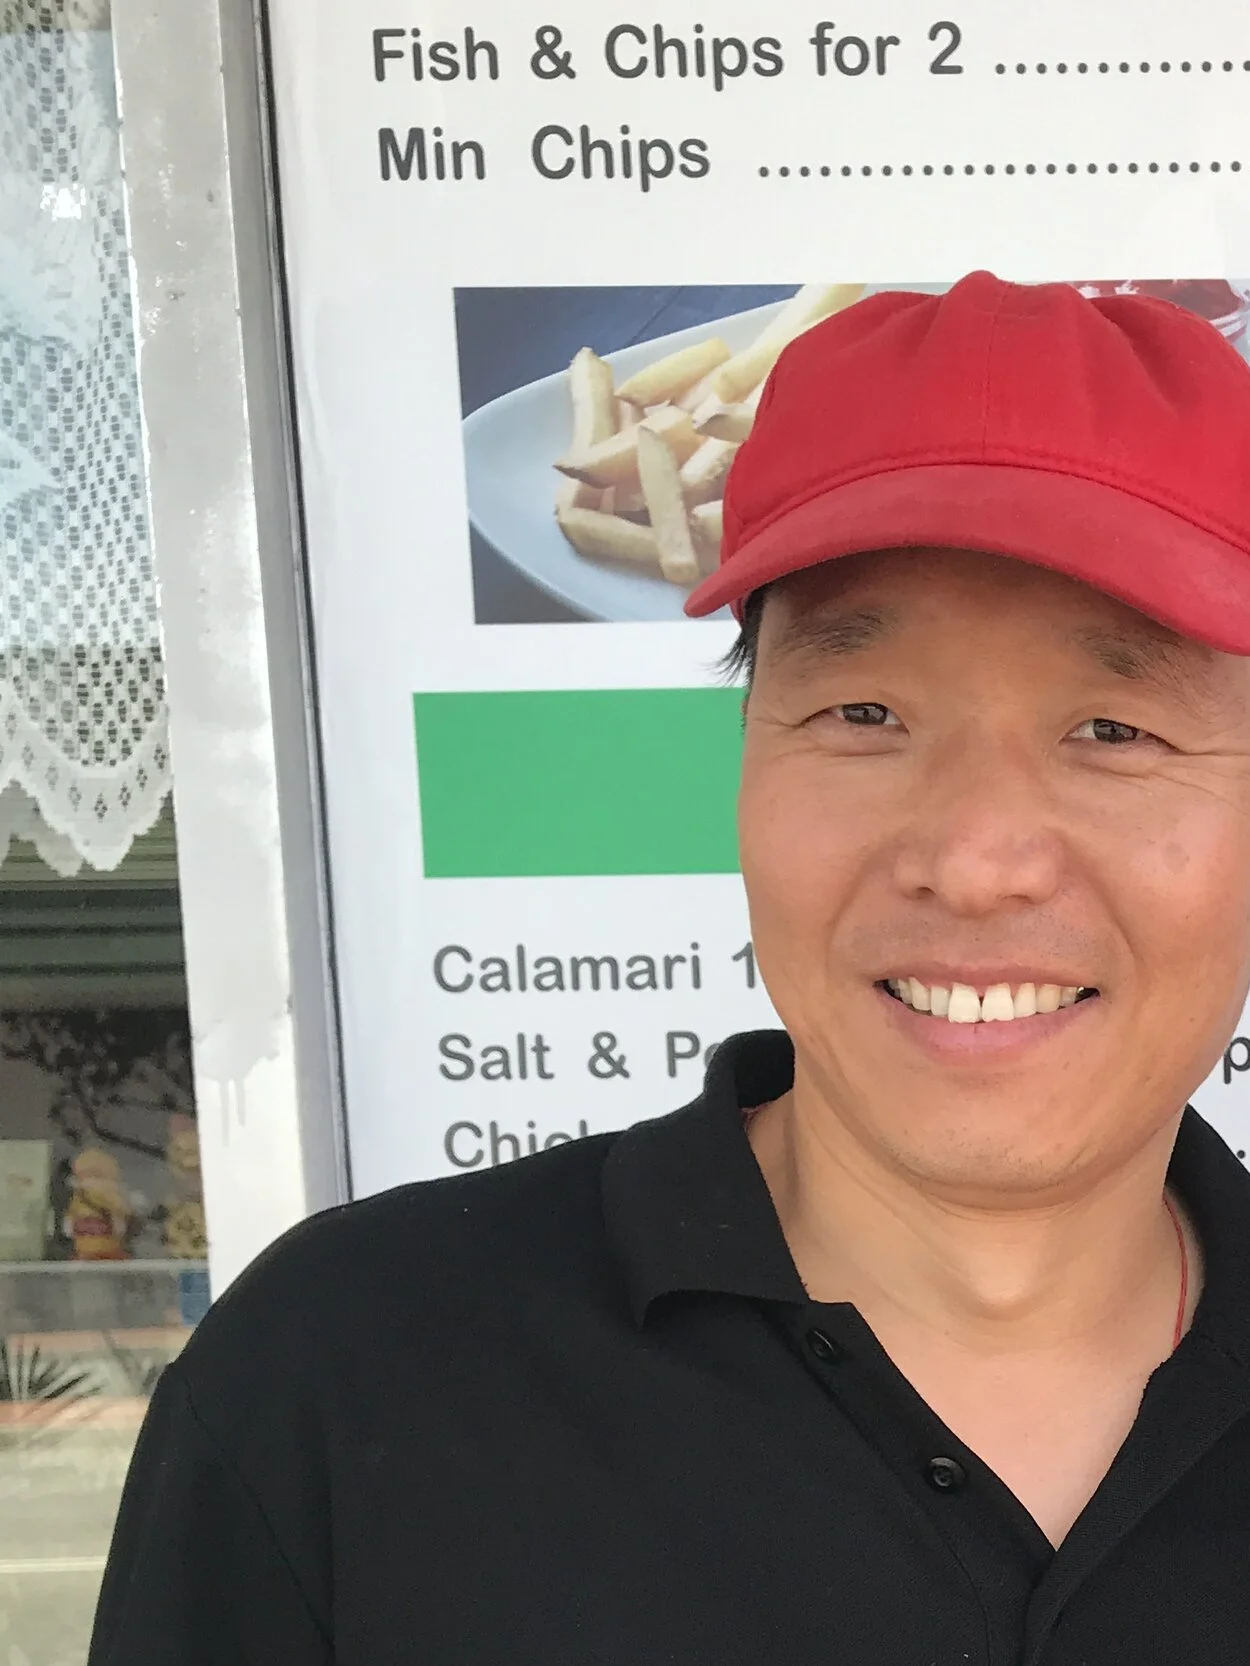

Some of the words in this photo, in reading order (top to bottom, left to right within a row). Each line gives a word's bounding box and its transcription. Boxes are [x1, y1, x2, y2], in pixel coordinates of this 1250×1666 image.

[372, 26, 499, 83] Fish
[530, 24, 577, 80] &
[604, 23, 784, 92] Chips
[809, 21, 901, 77] for
[928, 20, 963, 75] 2
[378, 126, 486, 182] Min
[531, 124, 710, 193] Chips
[433, 942, 701, 993] Calamari
[438, 1032, 555, 1081] Salt
[587, 1031, 630, 1079] &
